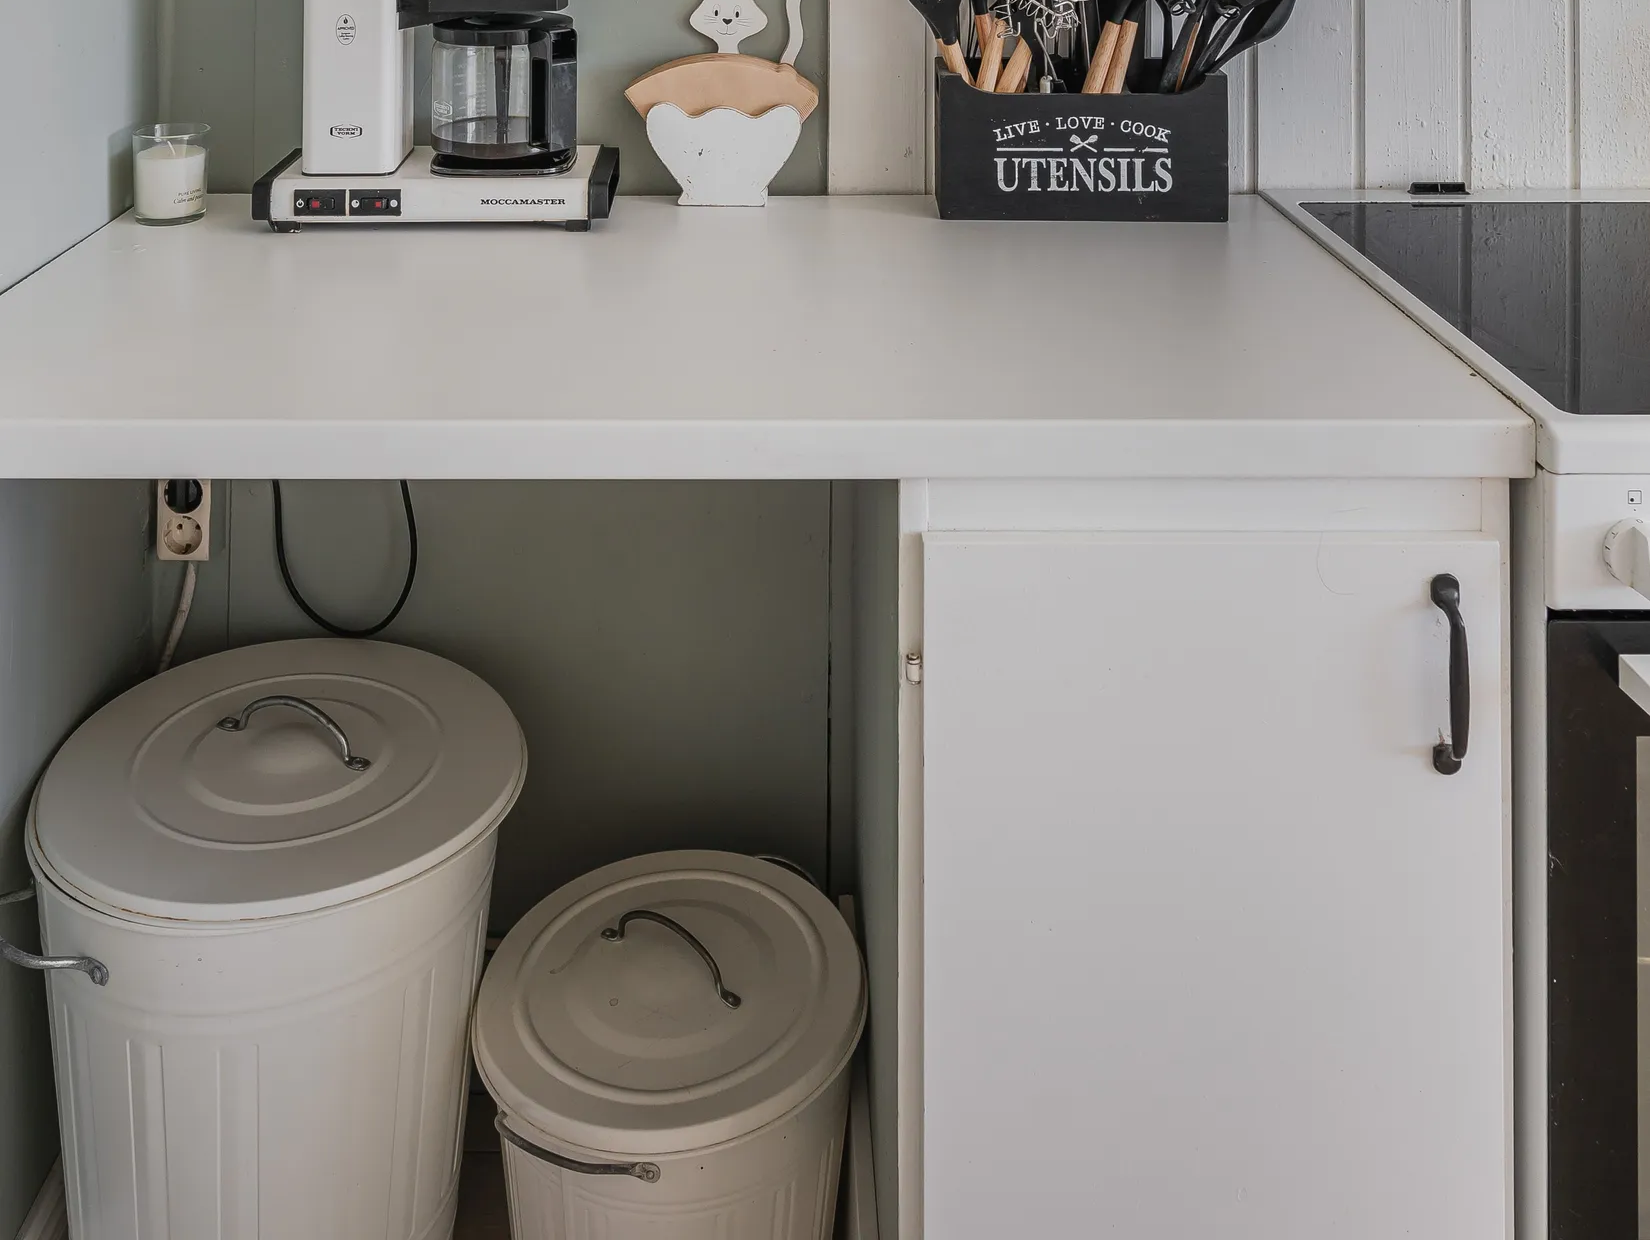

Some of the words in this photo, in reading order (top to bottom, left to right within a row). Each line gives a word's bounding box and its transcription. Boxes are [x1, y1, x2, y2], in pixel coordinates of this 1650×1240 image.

[993, 120, 1041, 142] LIVE
[1055, 116, 1105, 130] LOVE
[1120, 119, 1172, 143] COOK
[994, 157, 1173, 193] UTENSILS
